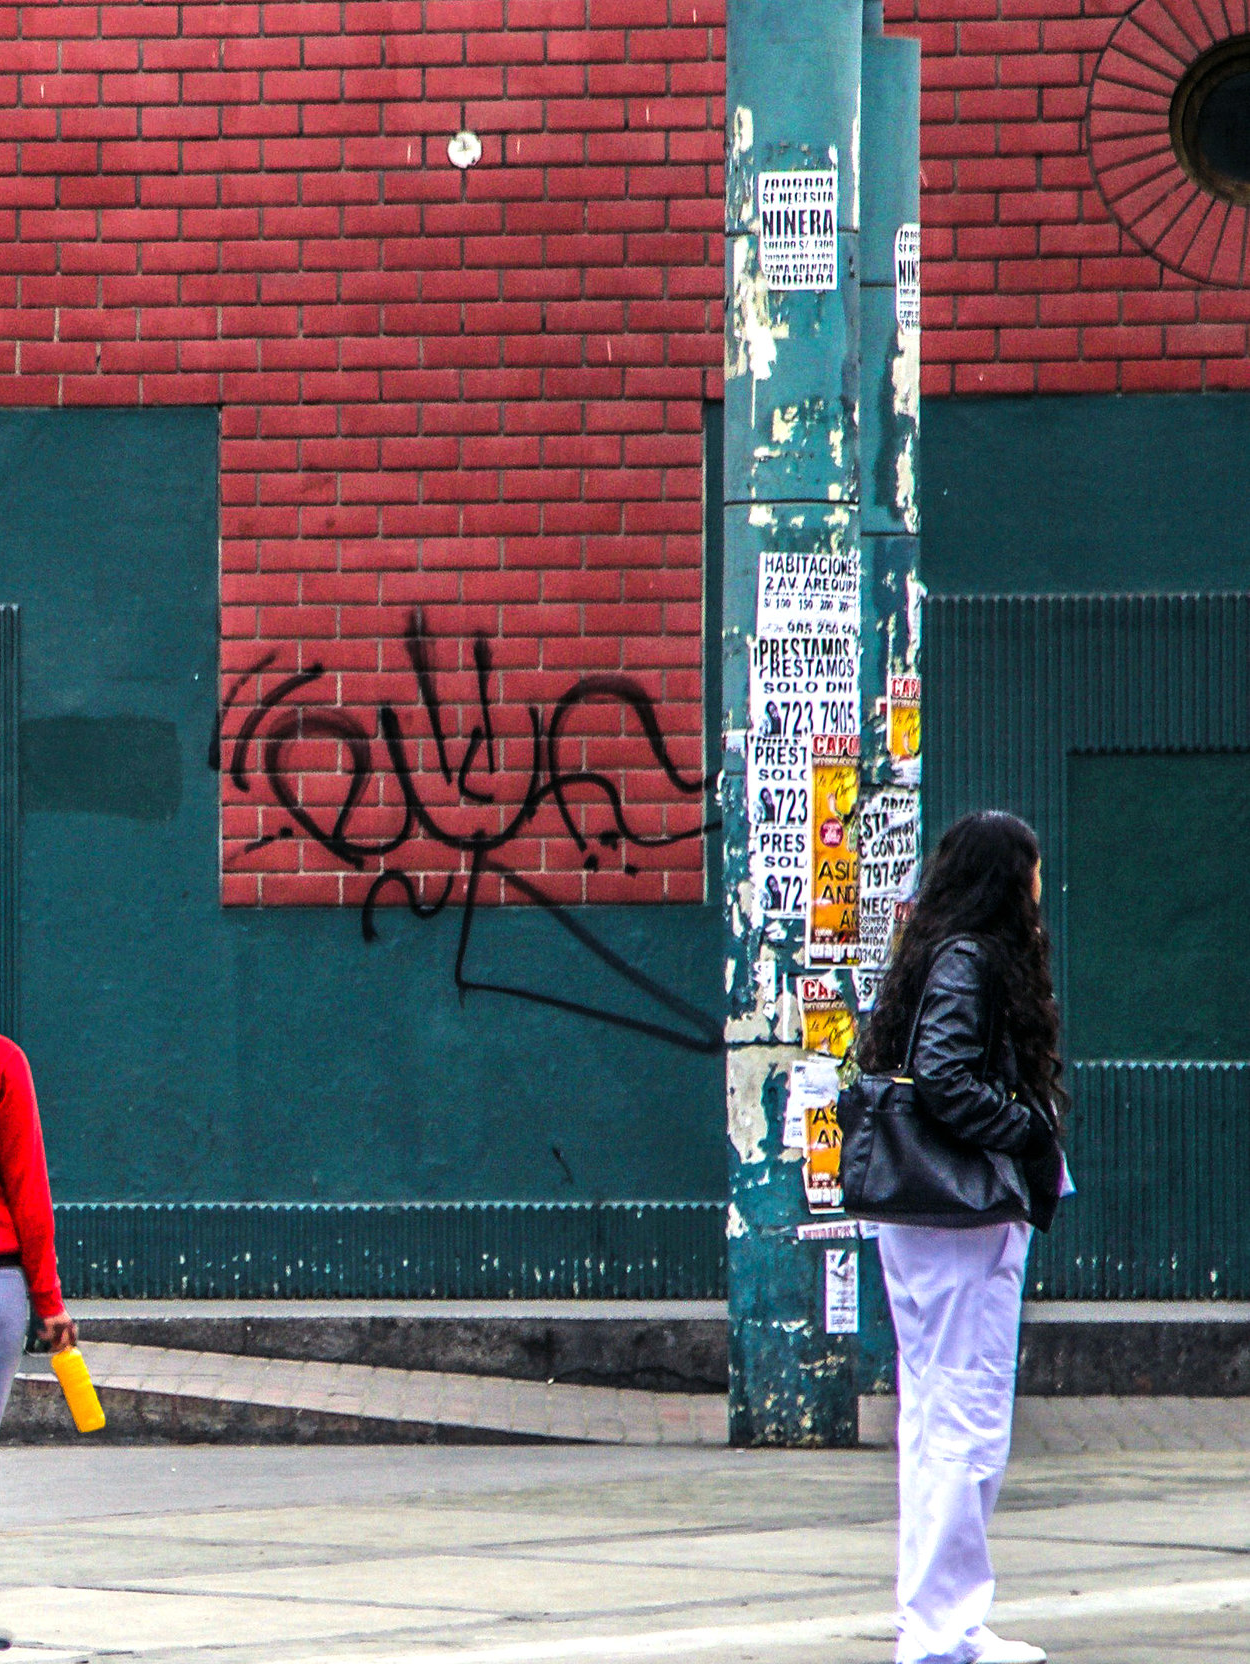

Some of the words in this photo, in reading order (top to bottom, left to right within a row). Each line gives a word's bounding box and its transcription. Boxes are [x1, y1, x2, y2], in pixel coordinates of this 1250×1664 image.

[763, 681, 818, 694] SOLO
[826, 681, 852, 694] DNI
[820, 701, 855, 734] 7905
[775, 788, 807, 825] 723
[764, 855, 807, 868] SOL
